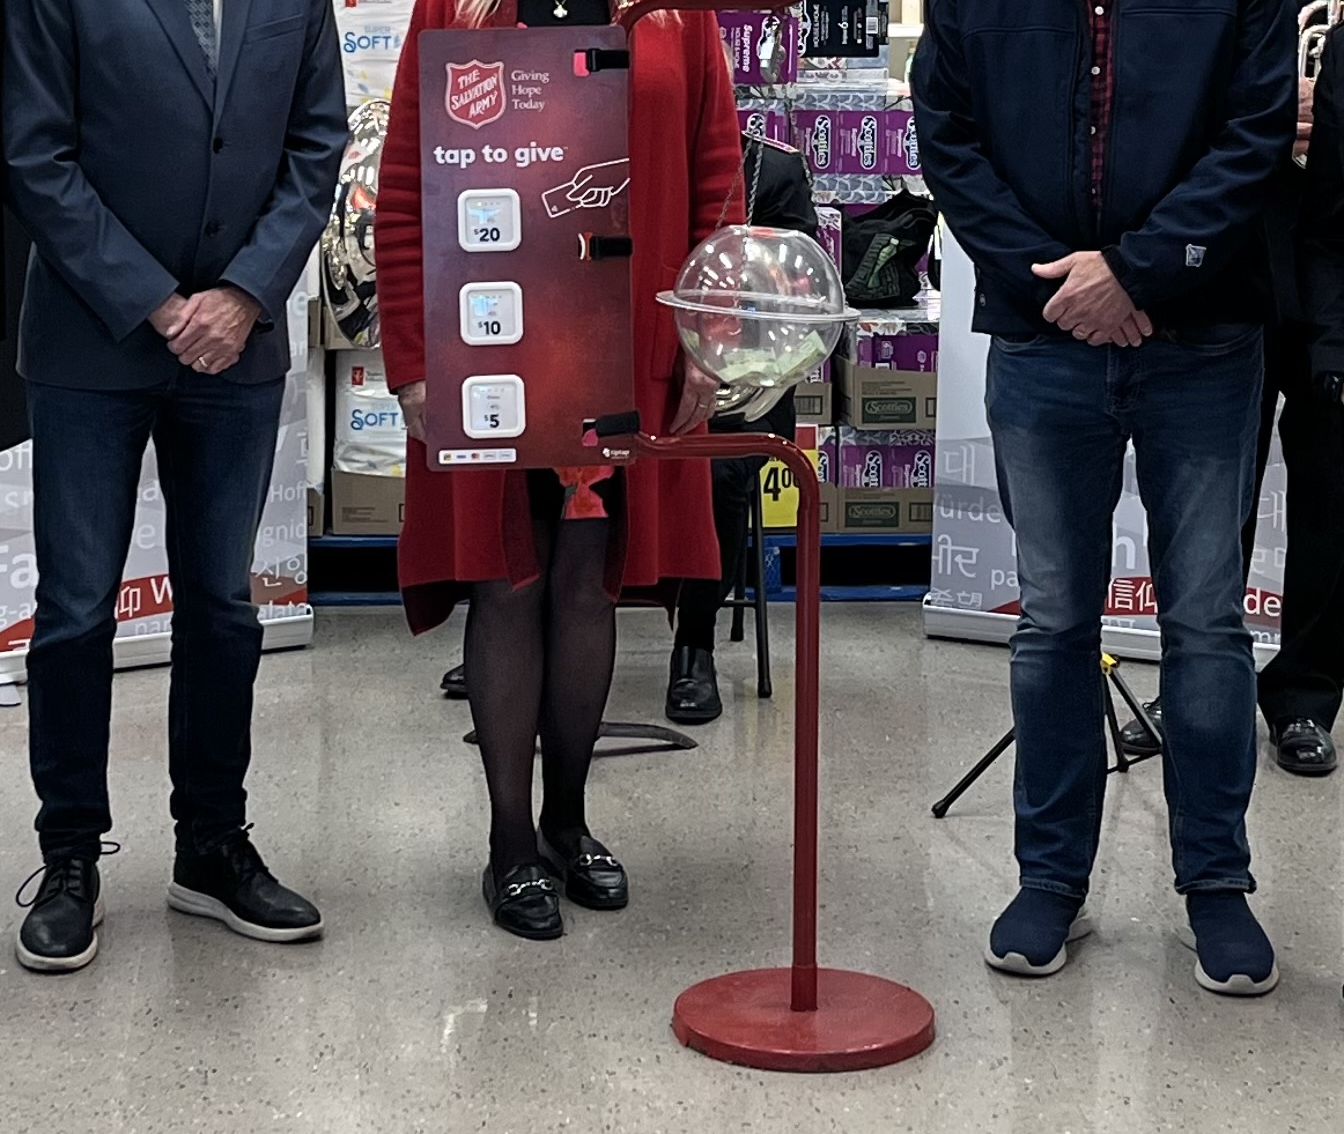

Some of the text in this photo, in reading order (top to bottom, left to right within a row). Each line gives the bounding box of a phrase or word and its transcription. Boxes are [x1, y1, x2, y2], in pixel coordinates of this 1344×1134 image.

[344, 31, 392, 53] SOFT
[742, 24, 753, 73] Supreme
[457, 69, 481, 89] THE
[511, 70, 550, 84] Giving
[451, 73, 498, 110] SALVATION
[511, 85, 542, 98] Hope
[468, 90, 498, 118] ARMY
[512, 99, 545, 113] Today
[817, 118, 829, 166] Scotties
[863, 119, 875, 167] Scotties
[433, 141, 564, 169] tap to give
[474, 227, 501, 243] $20
[477, 320, 502, 336] $10
[351, 408, 399, 431] SOFT
[484, 413, 501, 429] $5
